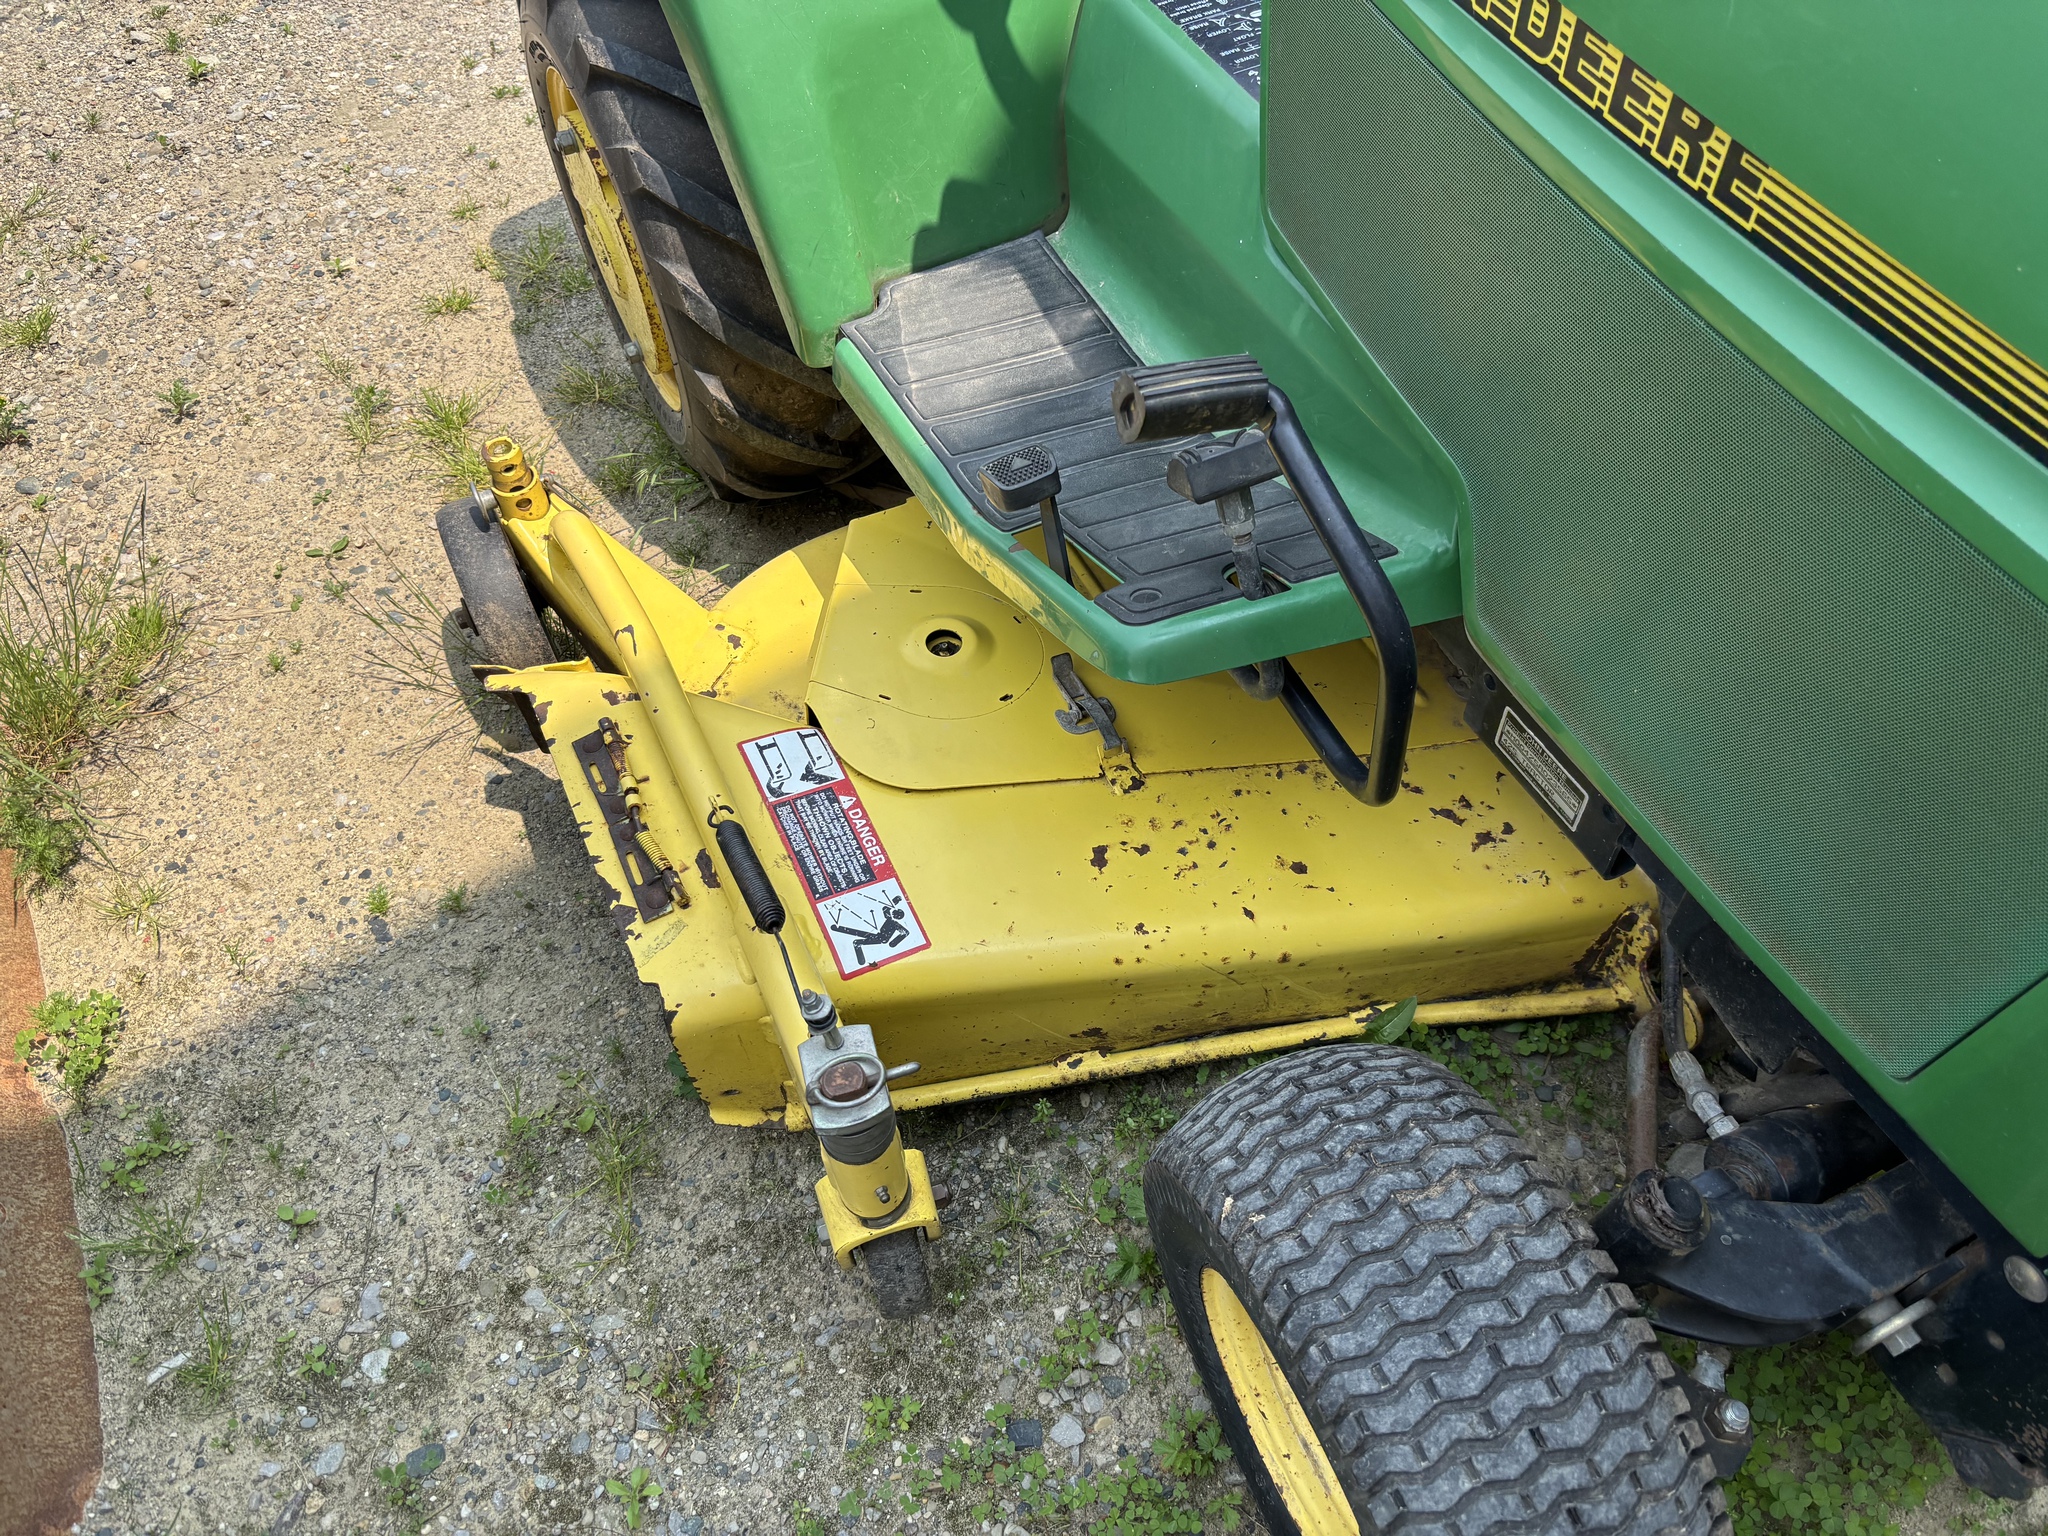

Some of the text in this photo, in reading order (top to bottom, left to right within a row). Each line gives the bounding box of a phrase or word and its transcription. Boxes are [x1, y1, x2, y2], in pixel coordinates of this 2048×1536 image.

[1179, 7, 1220, 23] PARK BRAKE
[1188, 21, 1209, 31] RAISE
[1206, 26, 1231, 37] LOWER
[1232, 31, 1254, 41] FLOAT
[1219, 46, 1240, 56] RAISE
[1233, 52, 1258, 64] LOWER
[1510, 0, 1769, 232] DEERE
[1502, 736, 1517, 756] 425
[1520, 756, 1555, 798] TRACTOR
[1522, 729, 1542, 754] JOHN
[1542, 752, 1567, 782] DEERE
[775, 807, 789, 829] CATCHER
[788, 835, 800, 851] PLACE
[788, 812, 797, 823] NOT
[793, 824, 808, 846] OPERATE
[804, 847, 817, 866] MOWER
[813, 866, 829, 890] WITHOUT
[811, 806, 848, 873] THROWN OBJECTS
[817, 833, 828, 848] CLEAR
[824, 848, 834, 860] AREA
[819, 805, 831, 823] MOWER
[845, 860, 860, 883] RUNNING
[822, 799, 831, 810] NOT
[827, 810, 836, 819] PUT
[844, 843, 854, 856] FEET
[849, 855, 863, 873] UNDER
[858, 872, 866, 881] OR
[830, 802, 867, 865] ROTATING BLADE
[846, 807, 887, 866] DANGER
[792, 832, 804, 849] CHUTE
[800, 849, 807, 857] OR
[811, 875, 824, 892] GRASS
